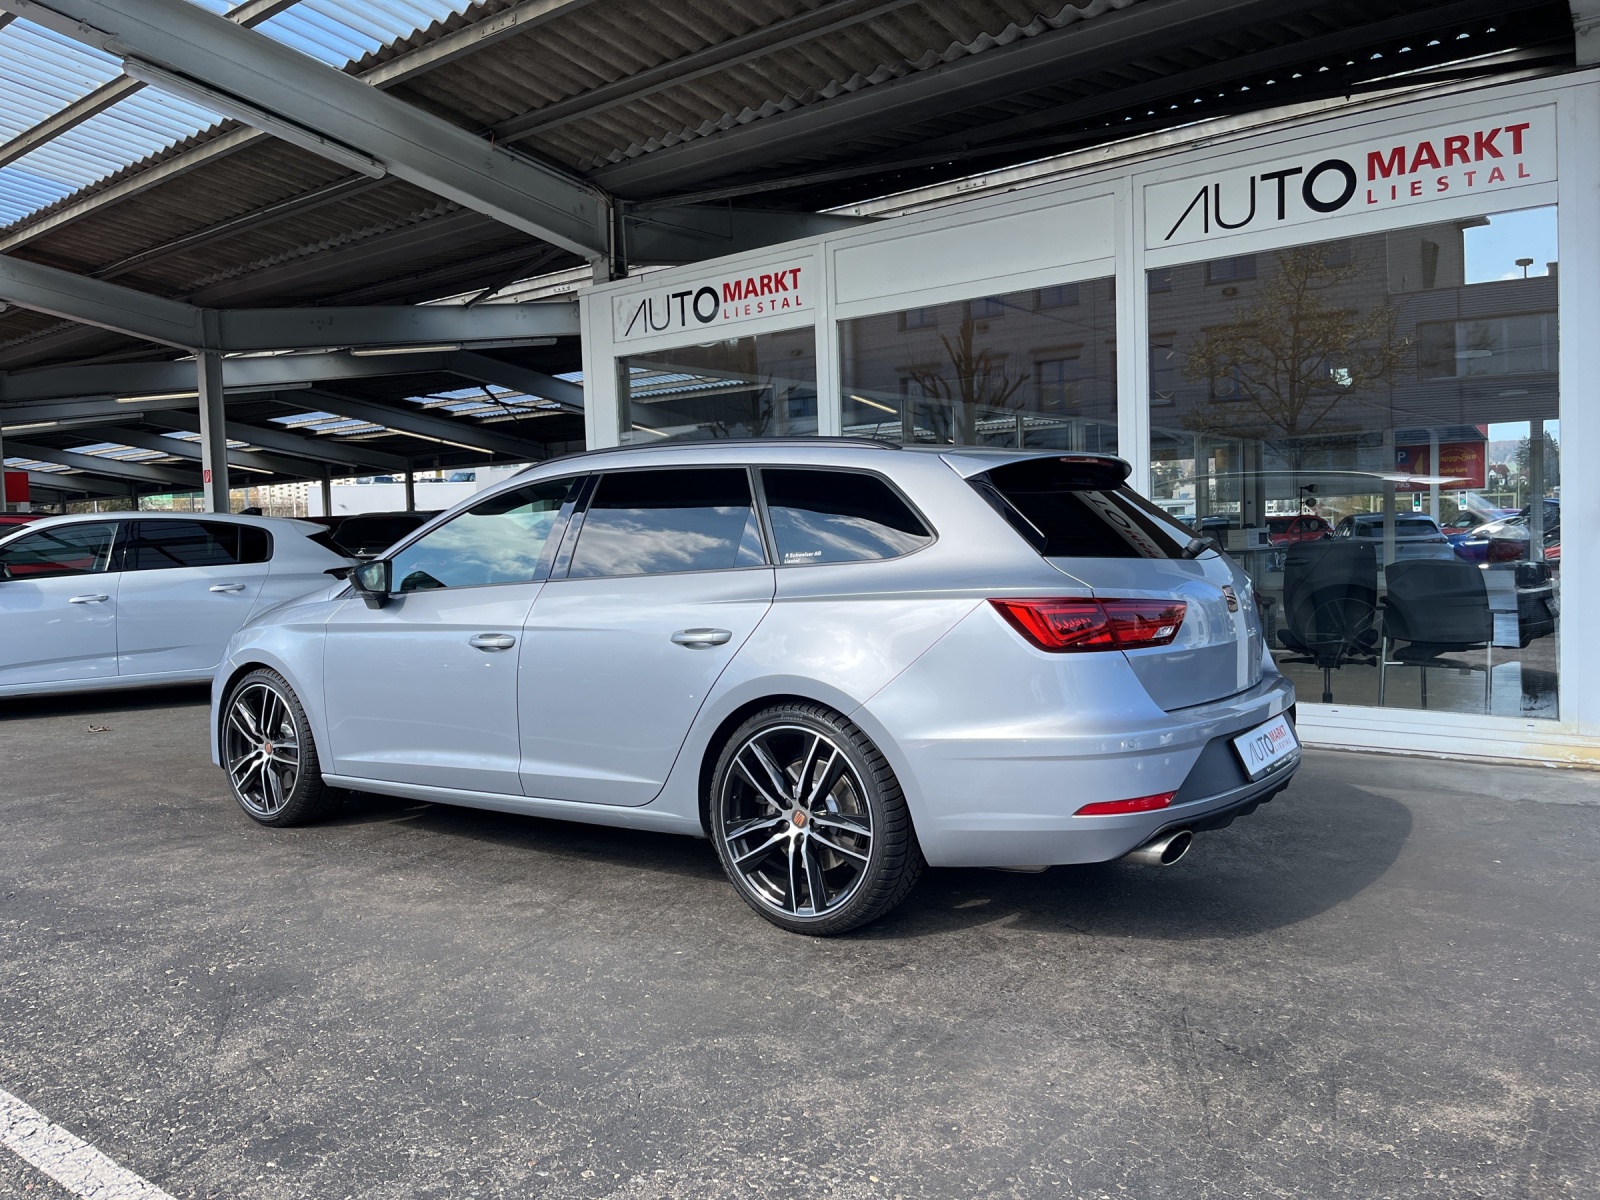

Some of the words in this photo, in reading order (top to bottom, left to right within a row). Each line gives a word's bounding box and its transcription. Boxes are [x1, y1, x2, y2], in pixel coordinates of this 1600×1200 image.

[1164, 158, 1357, 241] AUTO
[1366, 122, 1531, 181] MARKT
[1366, 162, 1531, 205] LIESTAL
[624, 286, 720, 337] AUTO
[722, 267, 802, 303] MARKT
[723, 297, 803, 320] LIESTAL
[1248, 734, 1275, 766] AUTO
[1268, 724, 1287, 743] MARKT
[1275, 739, 1292, 752] LIESTAL
